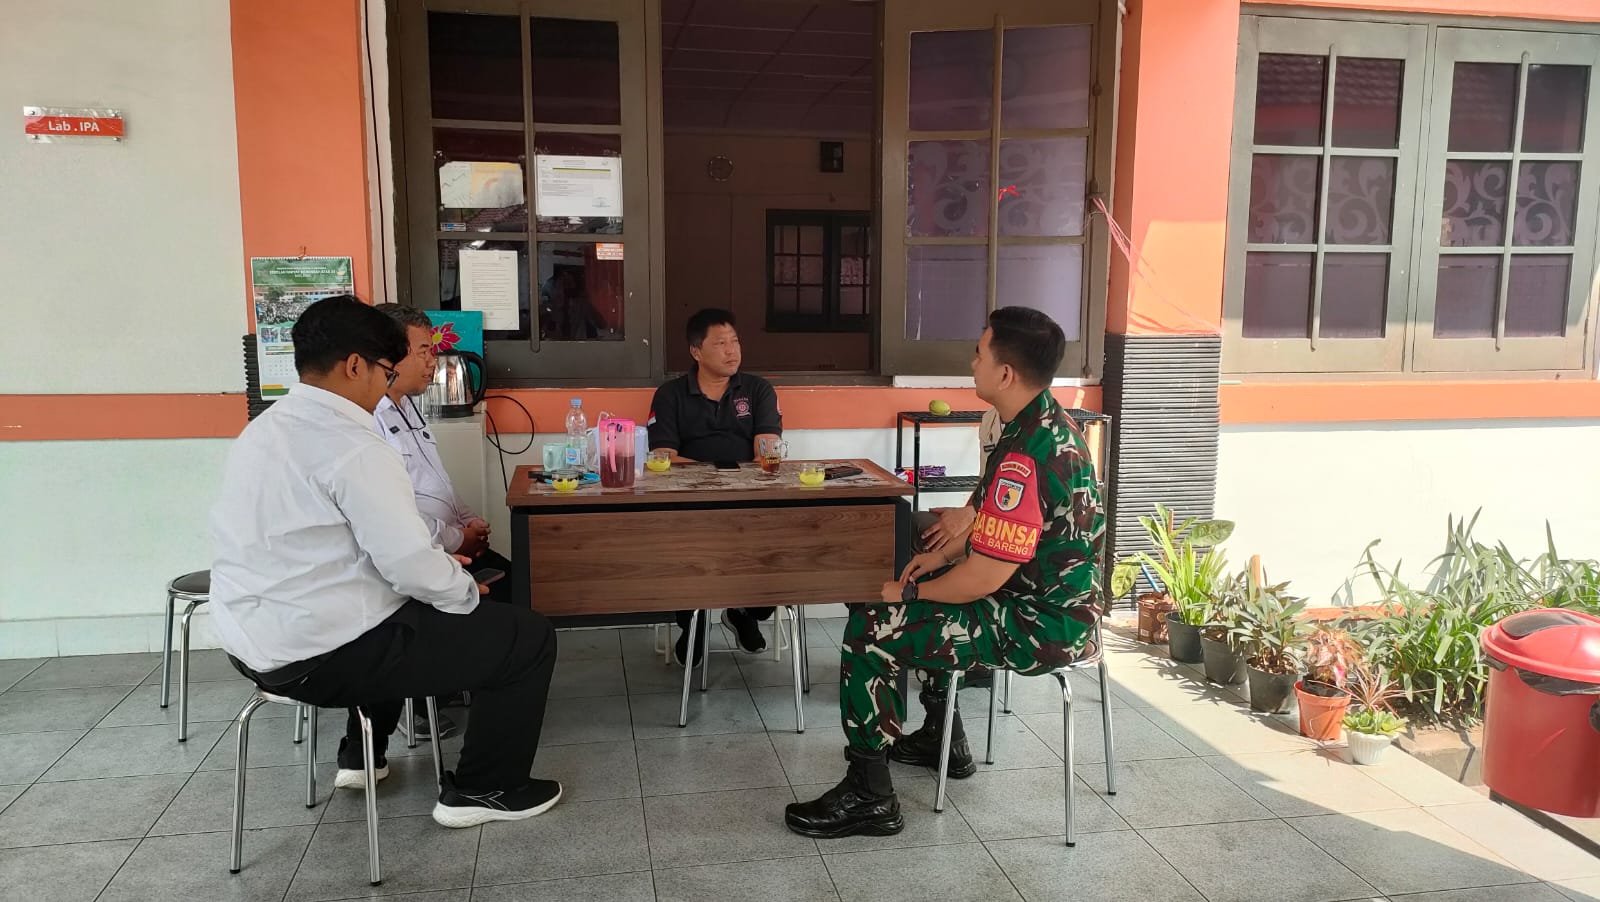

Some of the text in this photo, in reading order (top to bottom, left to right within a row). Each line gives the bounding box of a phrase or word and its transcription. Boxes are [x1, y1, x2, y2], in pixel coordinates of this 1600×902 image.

[48, 121, 71, 131] Lab
[79, 122, 100, 132] IPA
[987, 537, 1029, 556] BARENG
